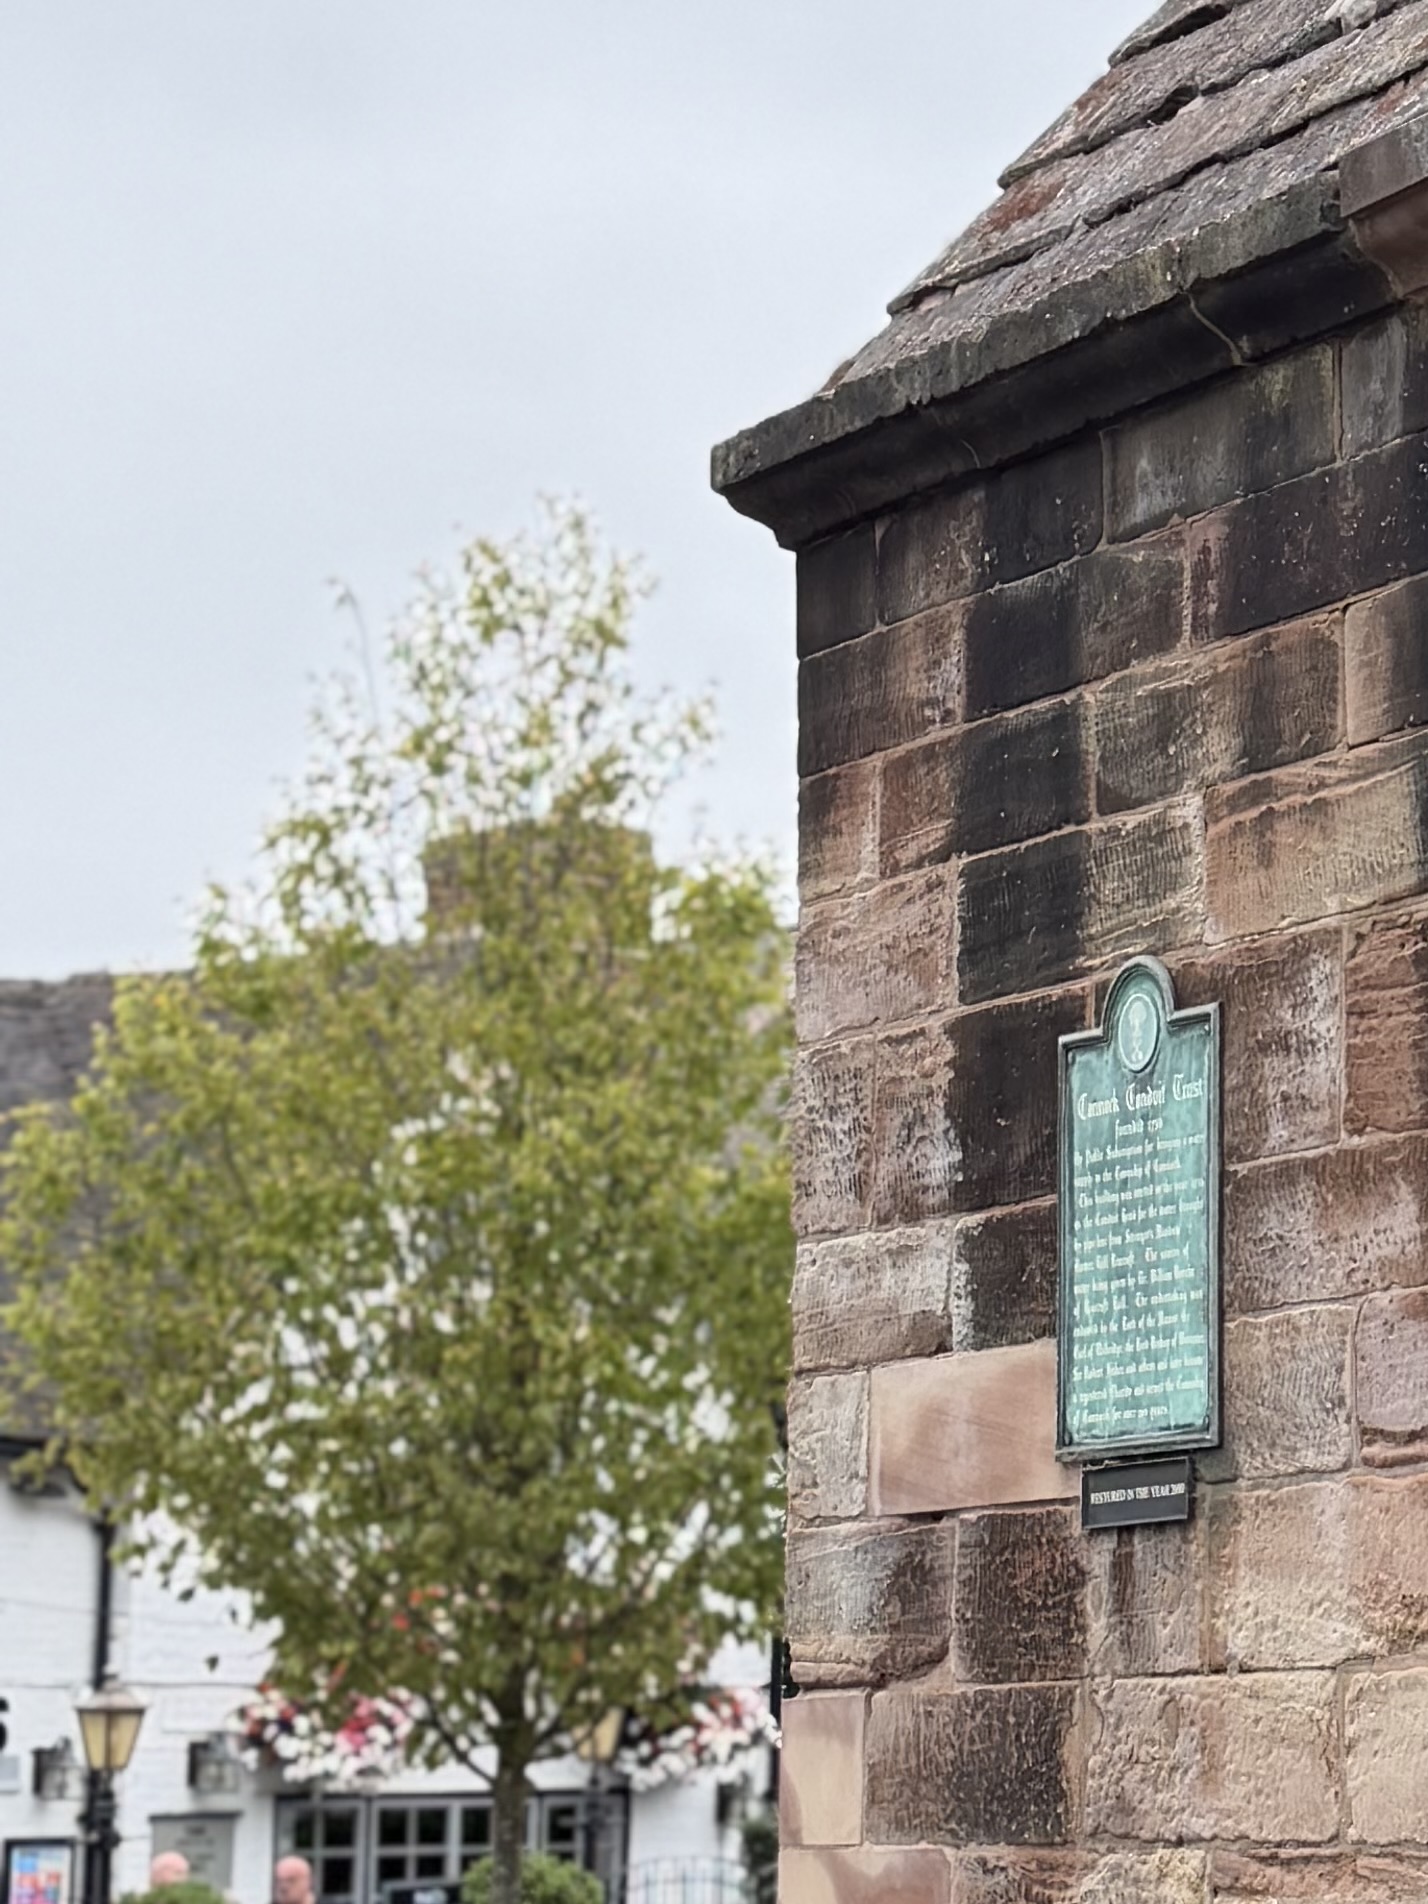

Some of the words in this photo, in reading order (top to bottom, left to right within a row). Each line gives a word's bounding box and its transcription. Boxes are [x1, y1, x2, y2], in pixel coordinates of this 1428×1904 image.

[1077, 1088, 1120, 1120] Cannock
[1126, 1080, 1166, 1111] Conduit
[1173, 1073, 1203, 1101] Trust
[1115, 1118, 1144, 1149] founded
[1091, 1489, 1125, 1504] RESTORED
[1136, 1487, 1149, 1498] THE
[1151, 1484, 1169, 1497] YEAR
